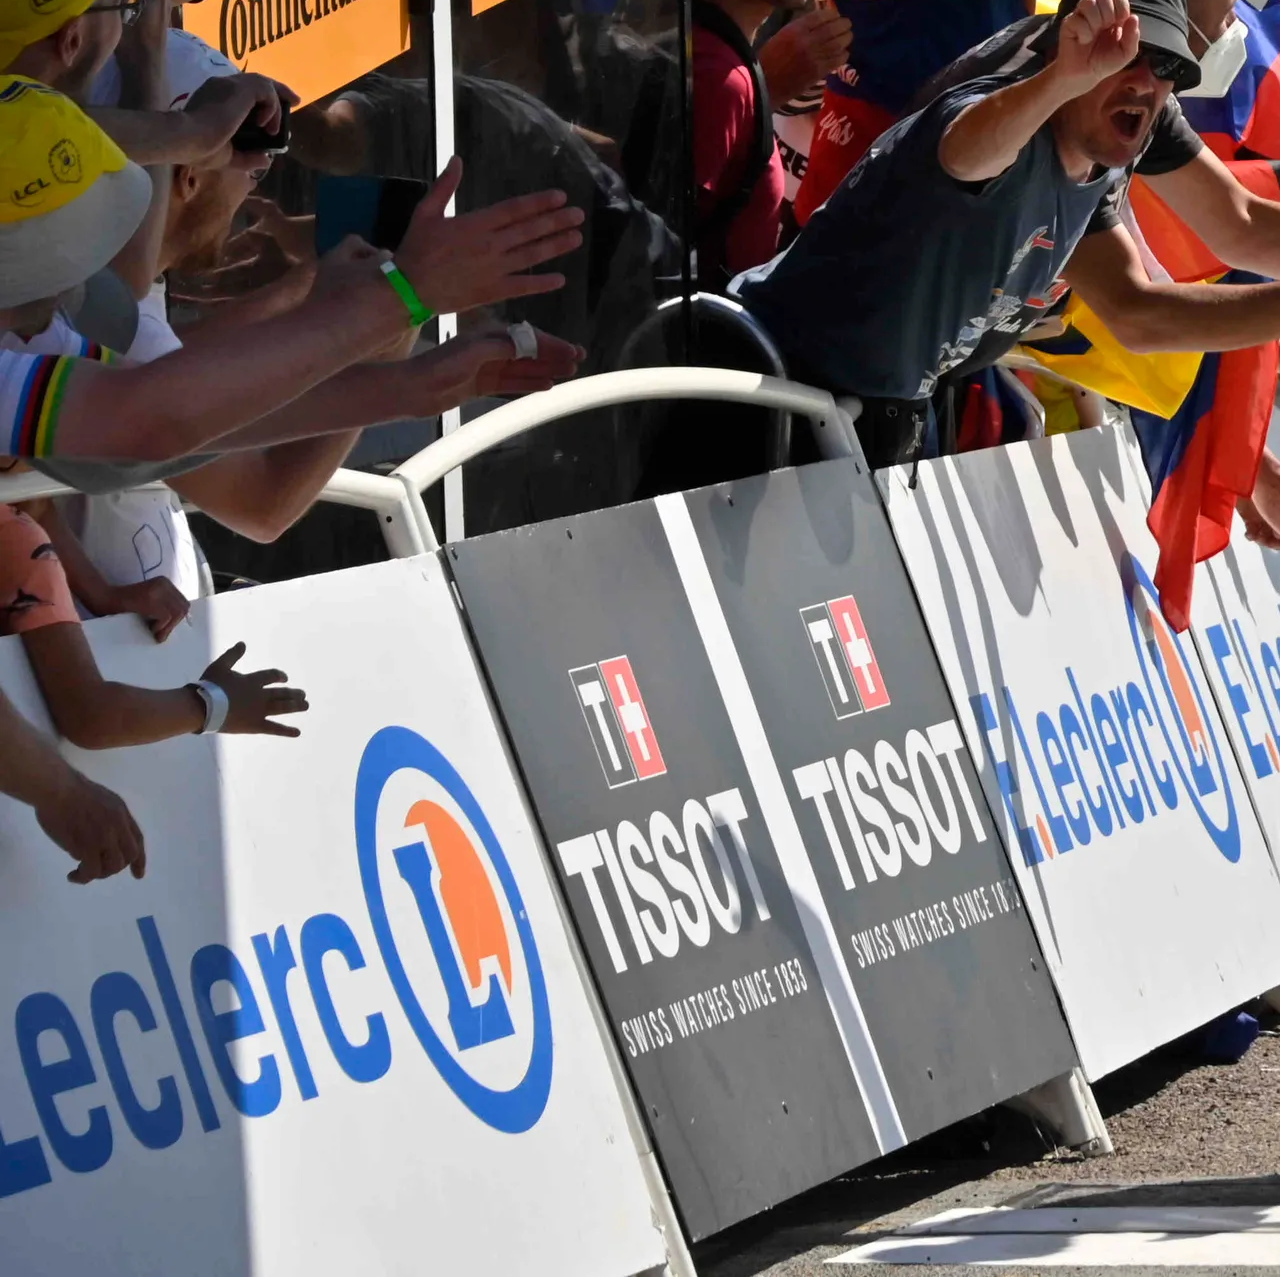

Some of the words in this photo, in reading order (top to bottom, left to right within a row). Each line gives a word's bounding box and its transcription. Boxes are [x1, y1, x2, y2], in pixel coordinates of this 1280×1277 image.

[14, 178, 50, 202] LCL
[792, 719, 987, 891] TISSOT
[968, 666, 1179, 868] E.Leclerc
[557, 788, 771, 975] TISSOT
[851, 922, 896, 970] SWISS
[893, 900, 955, 954] WATCHES
[951, 888, 995, 931] SINCE
[621, 1007, 675, 1059] SWISS
[670, 979, 736, 1039] WATCHES
[731, 965, 778, 1016] SINCE
[774, 957, 809, 999] 1853
